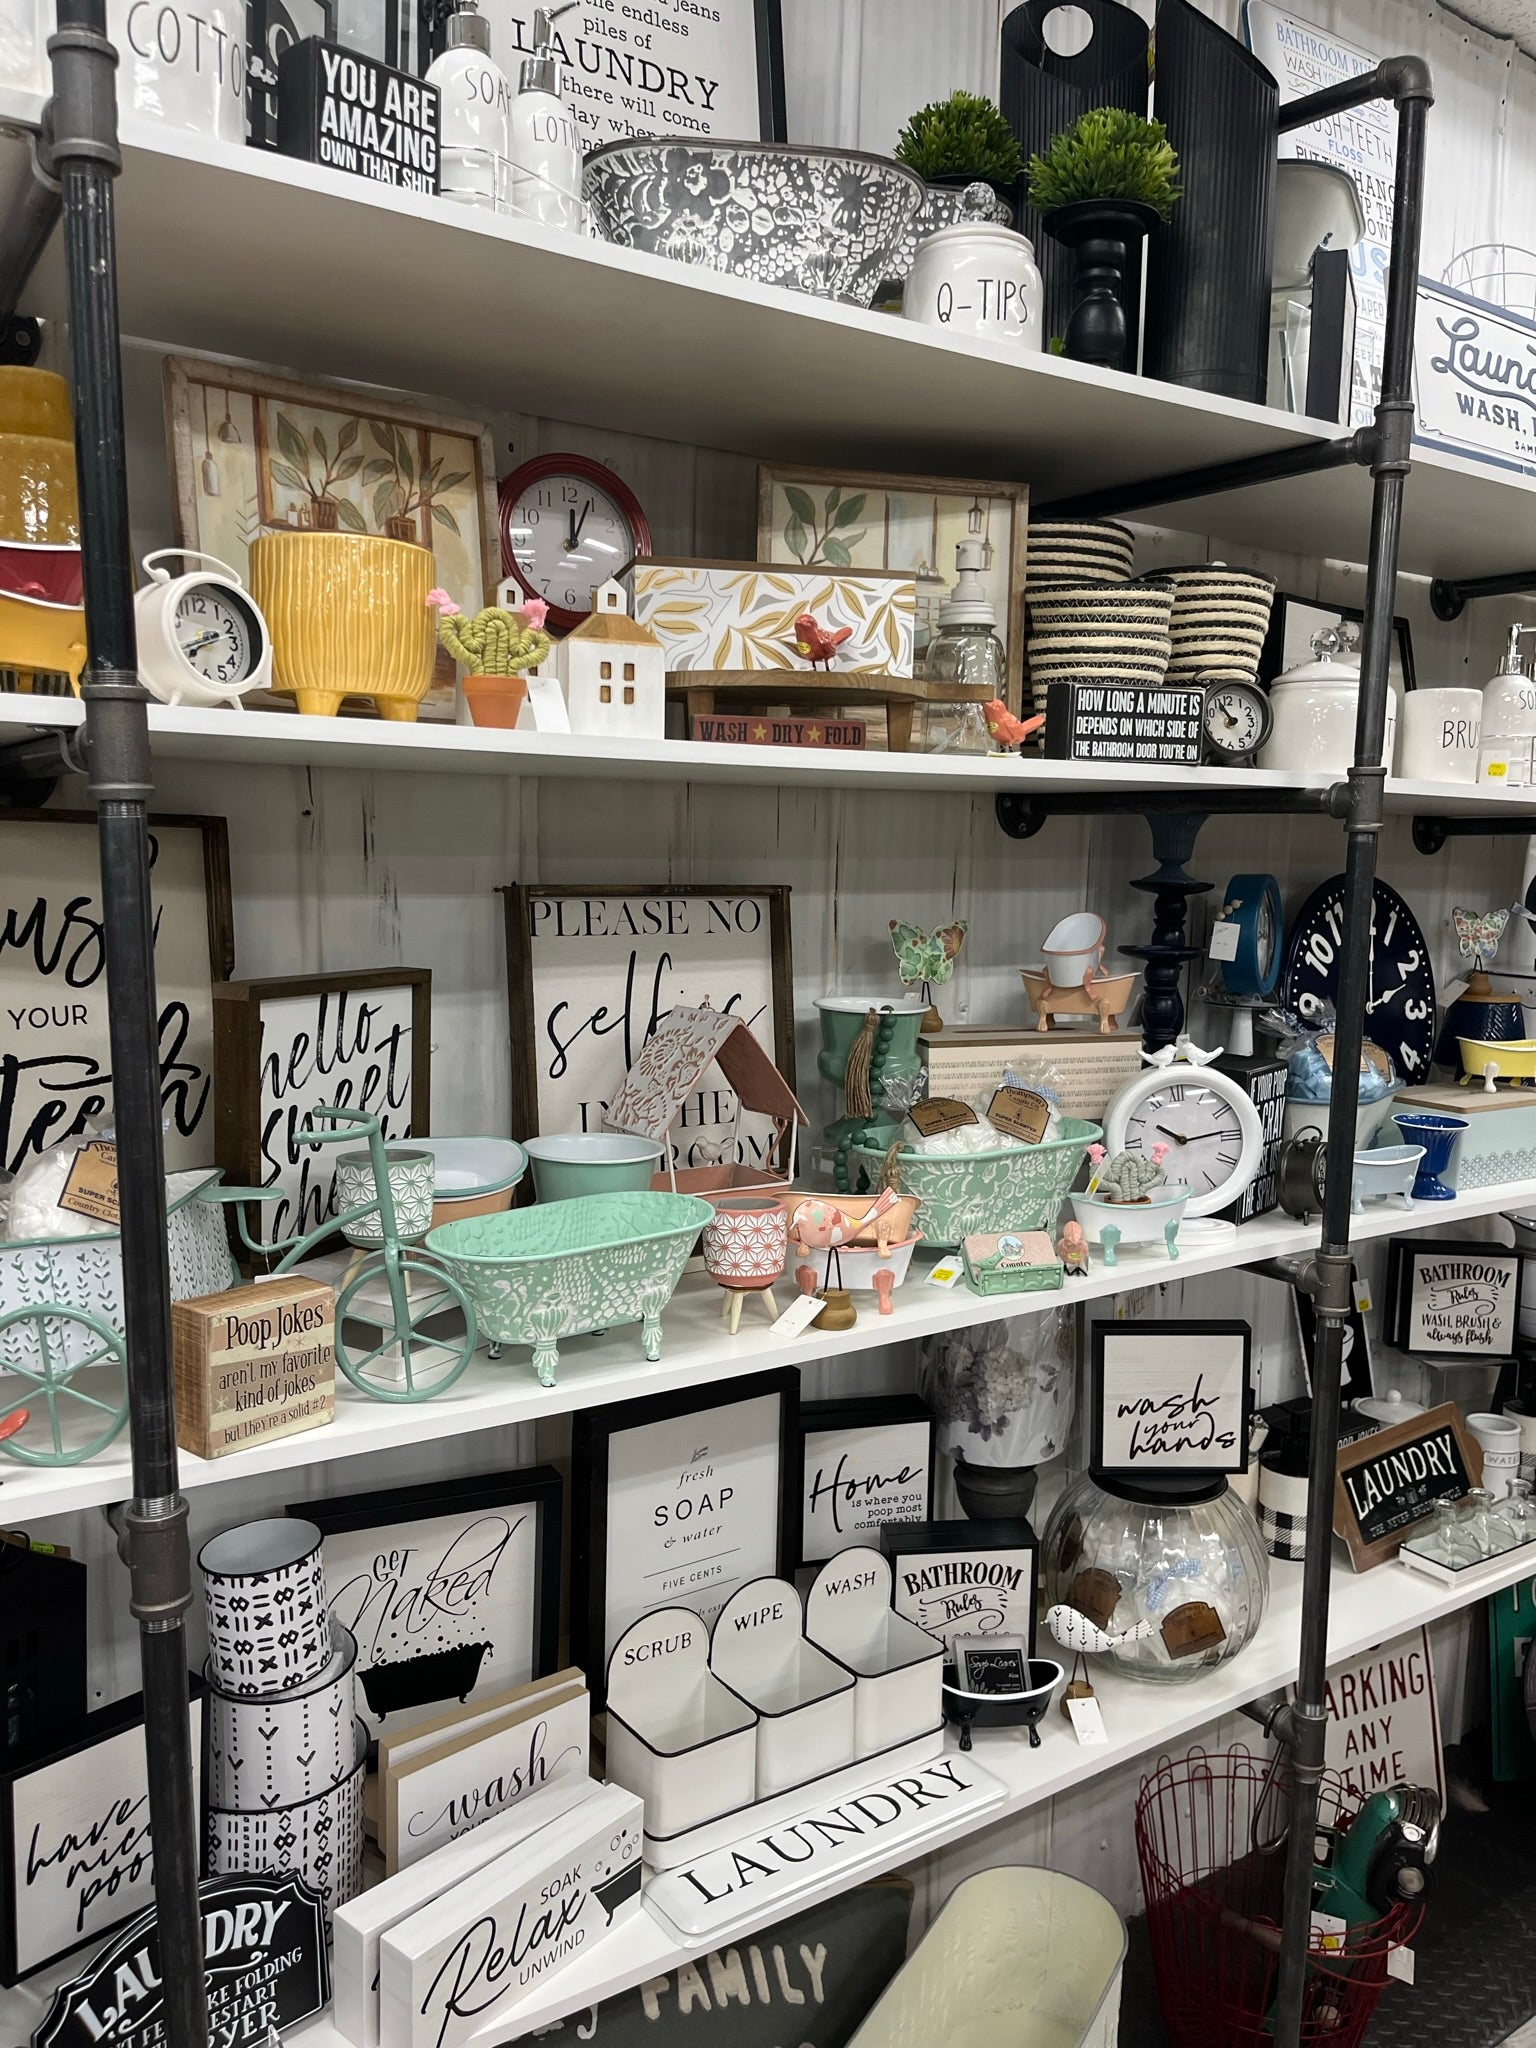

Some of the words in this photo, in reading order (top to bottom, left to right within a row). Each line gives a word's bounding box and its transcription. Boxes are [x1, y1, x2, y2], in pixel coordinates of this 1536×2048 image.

[622, 5, 689, 36] endless
[674, 0, 720, 22] jeans
[583, 17, 627, 42] piles
[634, 34, 652, 50] of
[1276, 22, 1348, 73] BATHROOM
[511, 18, 720, 111] LAUNDRY
[1283, 51, 1322, 82] WASH
[320, 48, 378, 109] YOU
[383, 71, 438, 135] ARE
[562, 75, 613, 104] there
[620, 95, 656, 118] will
[662, 109, 711, 134] come
[320, 95, 437, 174] AMAZING
[1346, 116, 1394, 168] TEETH
[1328, 138, 1364, 164] FLOSS
[320, 138, 357, 171] OWN
[360, 151, 398, 187] THAT
[402, 165, 436, 196] SHIT
[937, 279, 1028, 324] Q-TIPS
[1456, 391, 1527, 436] WASH,
[538, 489, 551, 508] 11
[562, 486, 578, 504] 12
[522, 507, 540, 526] 10
[605, 518, 615, 534] 2
[540, 578, 552, 595] 7
[564, 588, 576, 605] 6
[192, 597, 207, 614] 12
[214, 604, 220, 621] 1
[223, 619, 234, 635] 2
[228, 636, 239, 652] 3
[217, 665, 228, 681] 5
[225, 654, 236, 669] 4
[1077, 689, 1104, 712] HOW
[1106, 690, 1135, 713] LONG
[1136, 692, 1145, 714] A
[1147, 693, 1188, 716] MINUTE
[1189, 695, 1201, 717] IS
[1223, 695, 1233, 707] 12
[1245, 707, 1252, 718] 2
[699, 720, 748, 742] WASH
[772, 723, 804, 745] DRY
[824, 725, 862, 746] FOLD
[1076, 716, 1118, 736] DEPENDS
[1120, 717, 1133, 736] ON
[1135, 718, 1165, 738] WHICH
[1166, 720, 1187, 739] SIDE
[1188, 721, 1200, 739] OF
[1248, 718, 1255, 728] 3
[1075, 740, 1091, 757] THE
[1091, 742, 1134, 759] BATHROOM
[1136, 743, 1157, 760] DOOR
[1158, 743, 1185, 760] YOU'RE
[1186, 744, 1198, 761] ON
[1238, 738, 1246, 749] 5
[529, 899, 690, 937] PLEASE
[704, 899, 761, 934] NO
[1383, 910, 1398, 947] 1
[1305, 932, 1334, 978] 10
[1396, 949, 1420, 981] 2
[8, 1004, 88, 1030] YOUR
[1299, 992, 1325, 1017] 9
[1404, 998, 1427, 1021] 3
[260, 991, 383, 1099] hello
[1399, 1041, 1421, 1071] 4
[1257, 1072, 1273, 1103] YOUR
[1262, 1096, 1286, 1143] CRAY
[68, 1197, 101, 1215] Country
[78, 1187, 106, 1201] SUPER
[1419, 1262, 1513, 1289] BATHROOM
[1447, 1286, 1479, 1305] Rules
[225, 1315, 272, 1351] Poop
[272, 1302, 324, 1350] Jokes
[1427, 1328, 1463, 1346] always
[1465, 1328, 1494, 1346] flush
[1455, 1314, 1490, 1331] BRUSH
[1492, 1317, 1502, 1330] &
[219, 1362, 256, 1391] aren't
[260, 1359, 279, 1379] my
[282, 1343, 331, 1374] favorite
[235, 1383, 264, 1413] kind
[267, 1378, 281, 1403] of
[281, 1373, 316, 1406] jokes
[1117, 1373, 1221, 1419] wash
[224, 1425, 242, 1444] but
[244, 1414, 279, 1436] they're
[280, 1412, 287, 1424] a
[288, 1402, 310, 1422] solid
[312, 1394, 326, 1411] #2
[1144, 1418, 1200, 1446] your
[1129, 1411, 1237, 1460] hands
[676, 1465, 714, 1489] fresh
[1347, 1433, 1458, 1521] LAUNDRY
[653, 1487, 734, 1527] SOAP
[809, 1453, 924, 1533] Home
[851, 1499, 862, 1508] is
[864, 1495, 899, 1507] where
[901, 1493, 922, 1504] you
[867, 1507, 893, 1518] poop
[895, 1503, 922, 1514] most
[664, 1536, 677, 1549] &
[682, 1524, 723, 1544] water
[328, 1515, 528, 1664] Naked
[662, 1576, 686, 1591] FIVE
[690, 1565, 723, 1583] CENTS
[825, 1570, 877, 1597] WASH
[901, 1562, 1024, 1597] BATHROOM
[733, 1602, 784, 1632] WIPE
[941, 1593, 983, 1620] Rules
[623, 1631, 693, 1666] SCRUB
[1322, 1652, 1425, 1722] ARKING
[1345, 1715, 1392, 1760] ANY
[407, 1720, 581, 1837] wash
[1340, 1750, 1407, 1798] TIME
[26, 1794, 149, 1886] have
[677, 1760, 974, 1905] LAUNDRY
[540, 1864, 582, 1905] SOAK
[234, 1946, 303, 1997] FOLDING
[421, 1889, 587, 2048] Relax
[519, 1928, 585, 1986] UNWIND
[640, 1942, 827, 2021] FAMILY
[210, 1979, 279, 2032] ESTART
